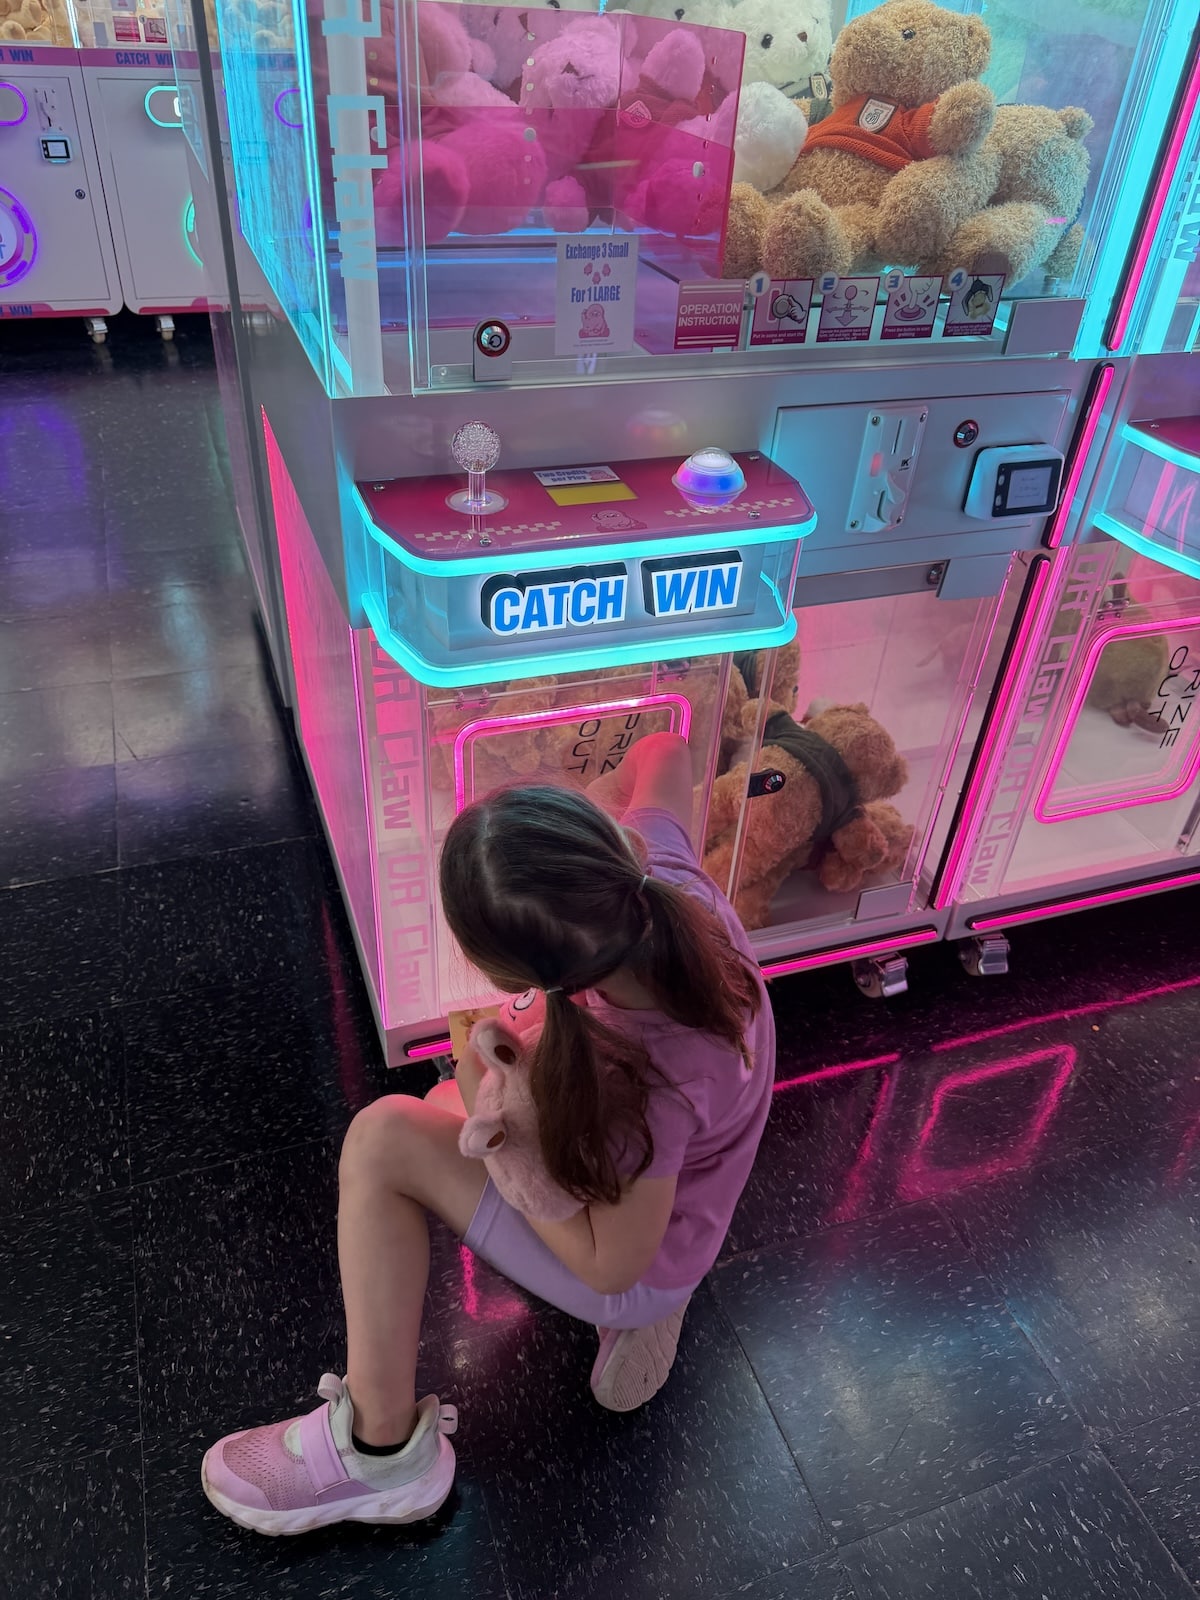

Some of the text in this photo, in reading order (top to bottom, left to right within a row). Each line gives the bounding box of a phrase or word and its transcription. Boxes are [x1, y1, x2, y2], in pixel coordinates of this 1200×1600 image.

[9, 49, 34, 62] WIN
[115, 52, 150, 65] CATCH
[327, 95, 388, 281] Claw
[565, 242, 629, 260] Exchange 3 Small
[754, 277, 764, 293] 1
[822, 277, 836, 291] 2
[886, 275, 900, 289] 3
[950, 271, 964, 286] 4
[571, 285, 621, 303] For 1 LARGE
[9, 304, 33, 317] WIN
[679, 303, 741, 315] OPERATION
[678, 315, 740, 327] INSTRUCTION
[492, 563, 741, 634] CATCH WIN
[1023, 633, 1077, 723] Claw
[1148, 645, 1189, 723] OUT
[567, 718, 602, 775] OUT
[377, 730, 421, 830] Claw
[970, 811, 1017, 885] Claw
[392, 923, 429, 1005] Claw
